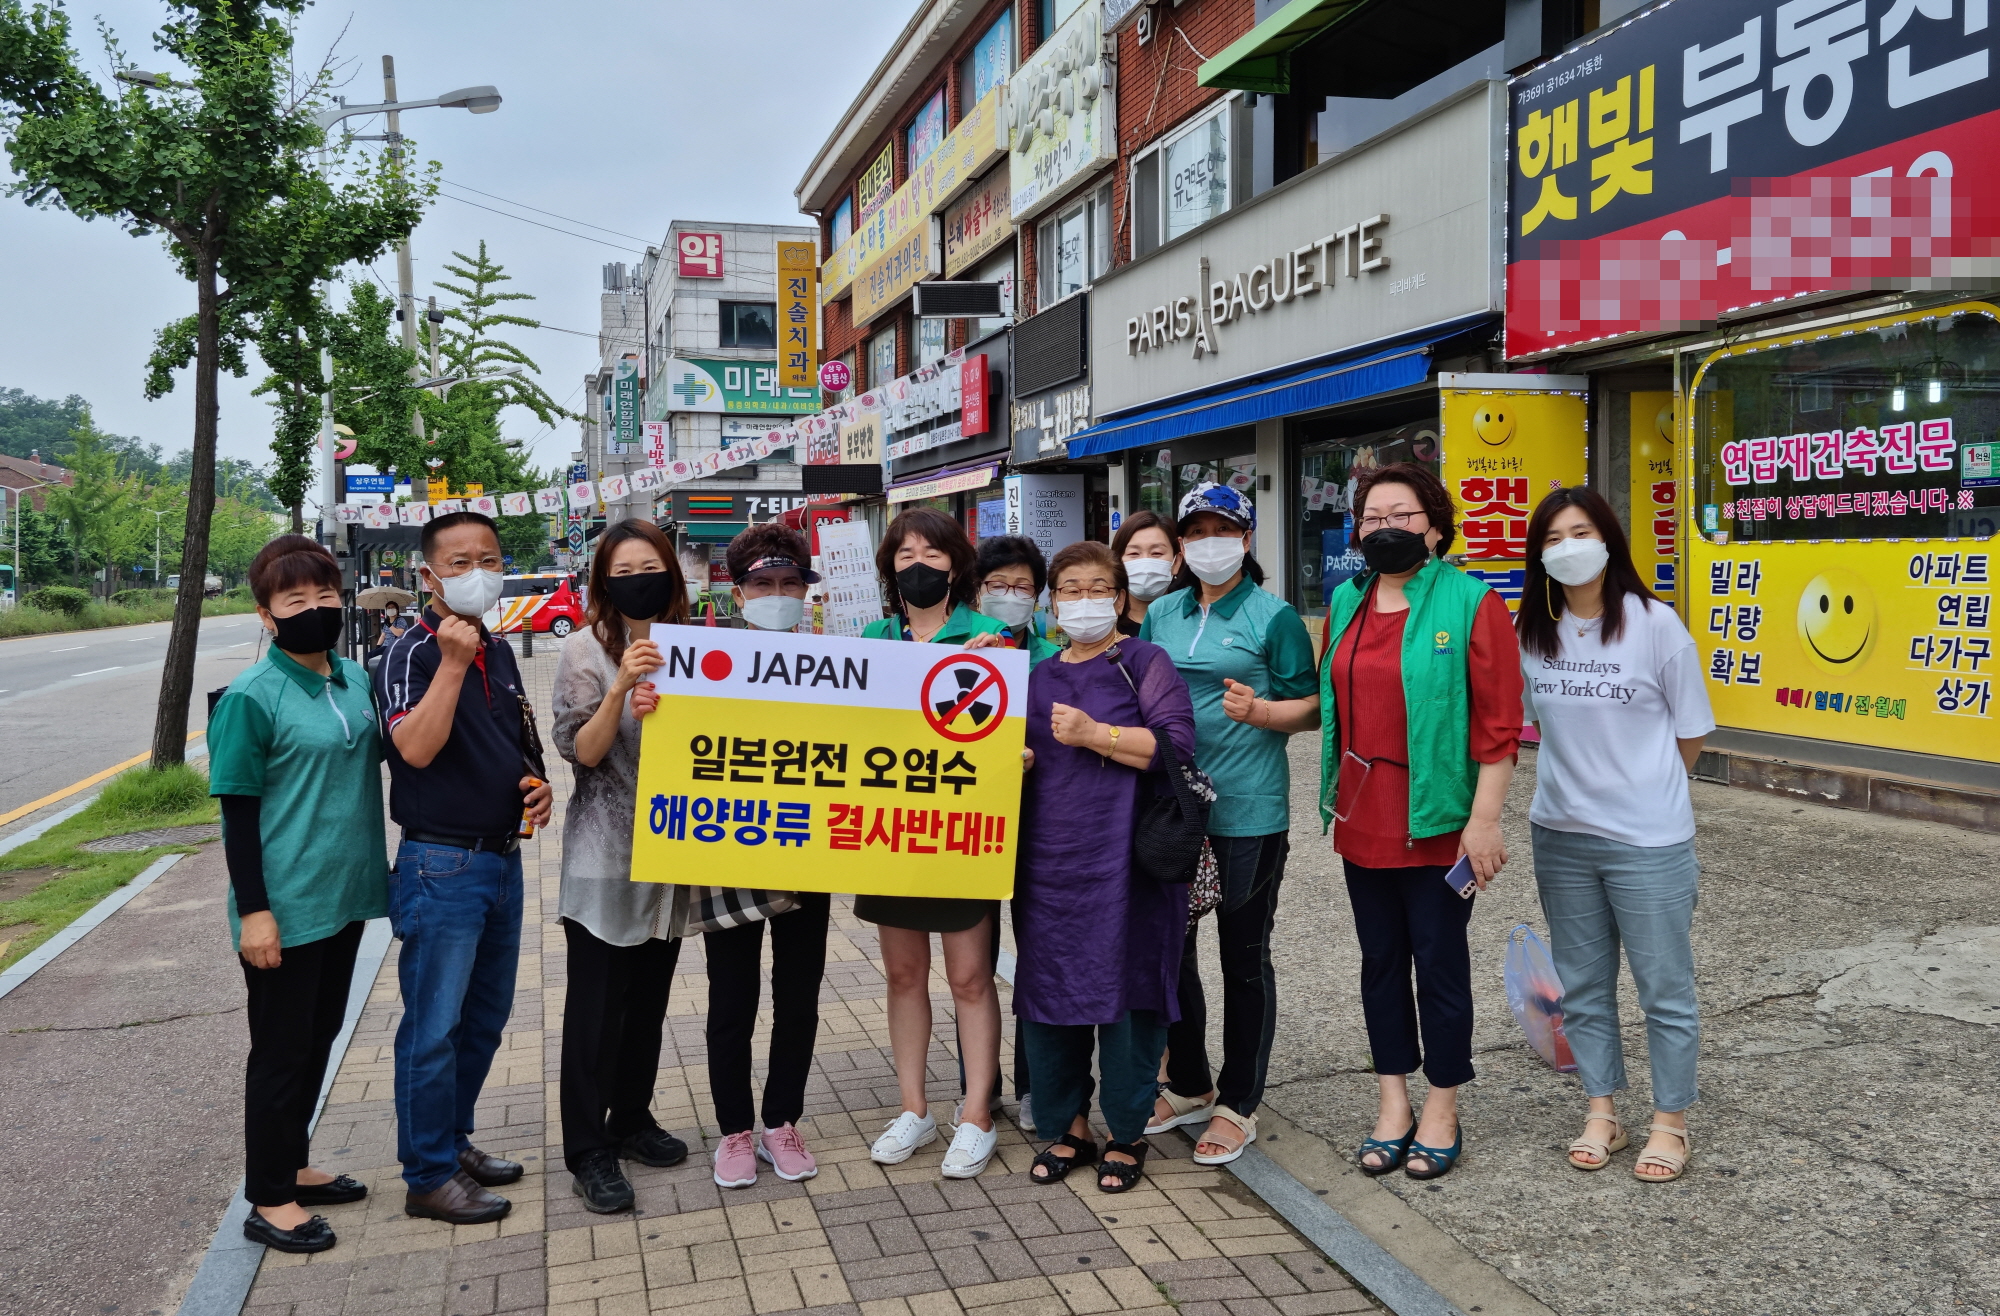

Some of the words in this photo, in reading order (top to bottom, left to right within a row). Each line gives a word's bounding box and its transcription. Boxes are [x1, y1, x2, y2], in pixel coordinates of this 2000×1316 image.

[1518, 64, 1655, 236] 햇빛
[861, 145, 891, 208] 임대문의
[680, 235, 720, 274] 약
[1127, 296, 1196, 356] PARIS
[1211, 214, 1391, 325] BAGUETTE
[1389, 272, 1427, 297] 파리바게뜨
[787, 277, 810, 374] 진솔치과
[791, 374, 807, 382] 의원
[824, 374, 848, 385] 부동산
[619, 381, 635, 440] 미래연합의원
[1038, 385, 1090, 453] 노래방
[648, 434, 664, 465] 김밥
[847, 423, 873, 461] 부부반찬
[1721, 418, 1956, 485] 연립재건축전문
[355, 477, 385, 485] 상우연립
[1467, 457, 1498, 473] 행복한
[1501, 457, 1523, 472] 하루!
[1036, 490, 1075, 498] Americano
[1036, 500, 1057, 508] Latte
[1036, 510, 1063, 519] Yogurt
[1326, 555, 1362, 571] PARIS
[1710, 559, 1762, 597] 빌라
[1908, 552, 1989, 586] 아파트
[1708, 604, 1762, 642] 다량
[1937, 593, 1990, 629] 연립
[748, 650, 868, 691] JAPAN
[1434, 647, 1454, 656] SMU
[1542, 655, 1621, 677] Saturdays
[1709, 648, 1763, 687] 확보
[1909, 634, 1992, 673] 다가구
[1936, 677, 1992, 716] 상가
[690, 734, 848, 789] 일본원전
[860, 746, 977, 796] 오염수
[649, 793, 811, 848] 해양방류
[827, 803, 1006, 857] 결사반대!!
